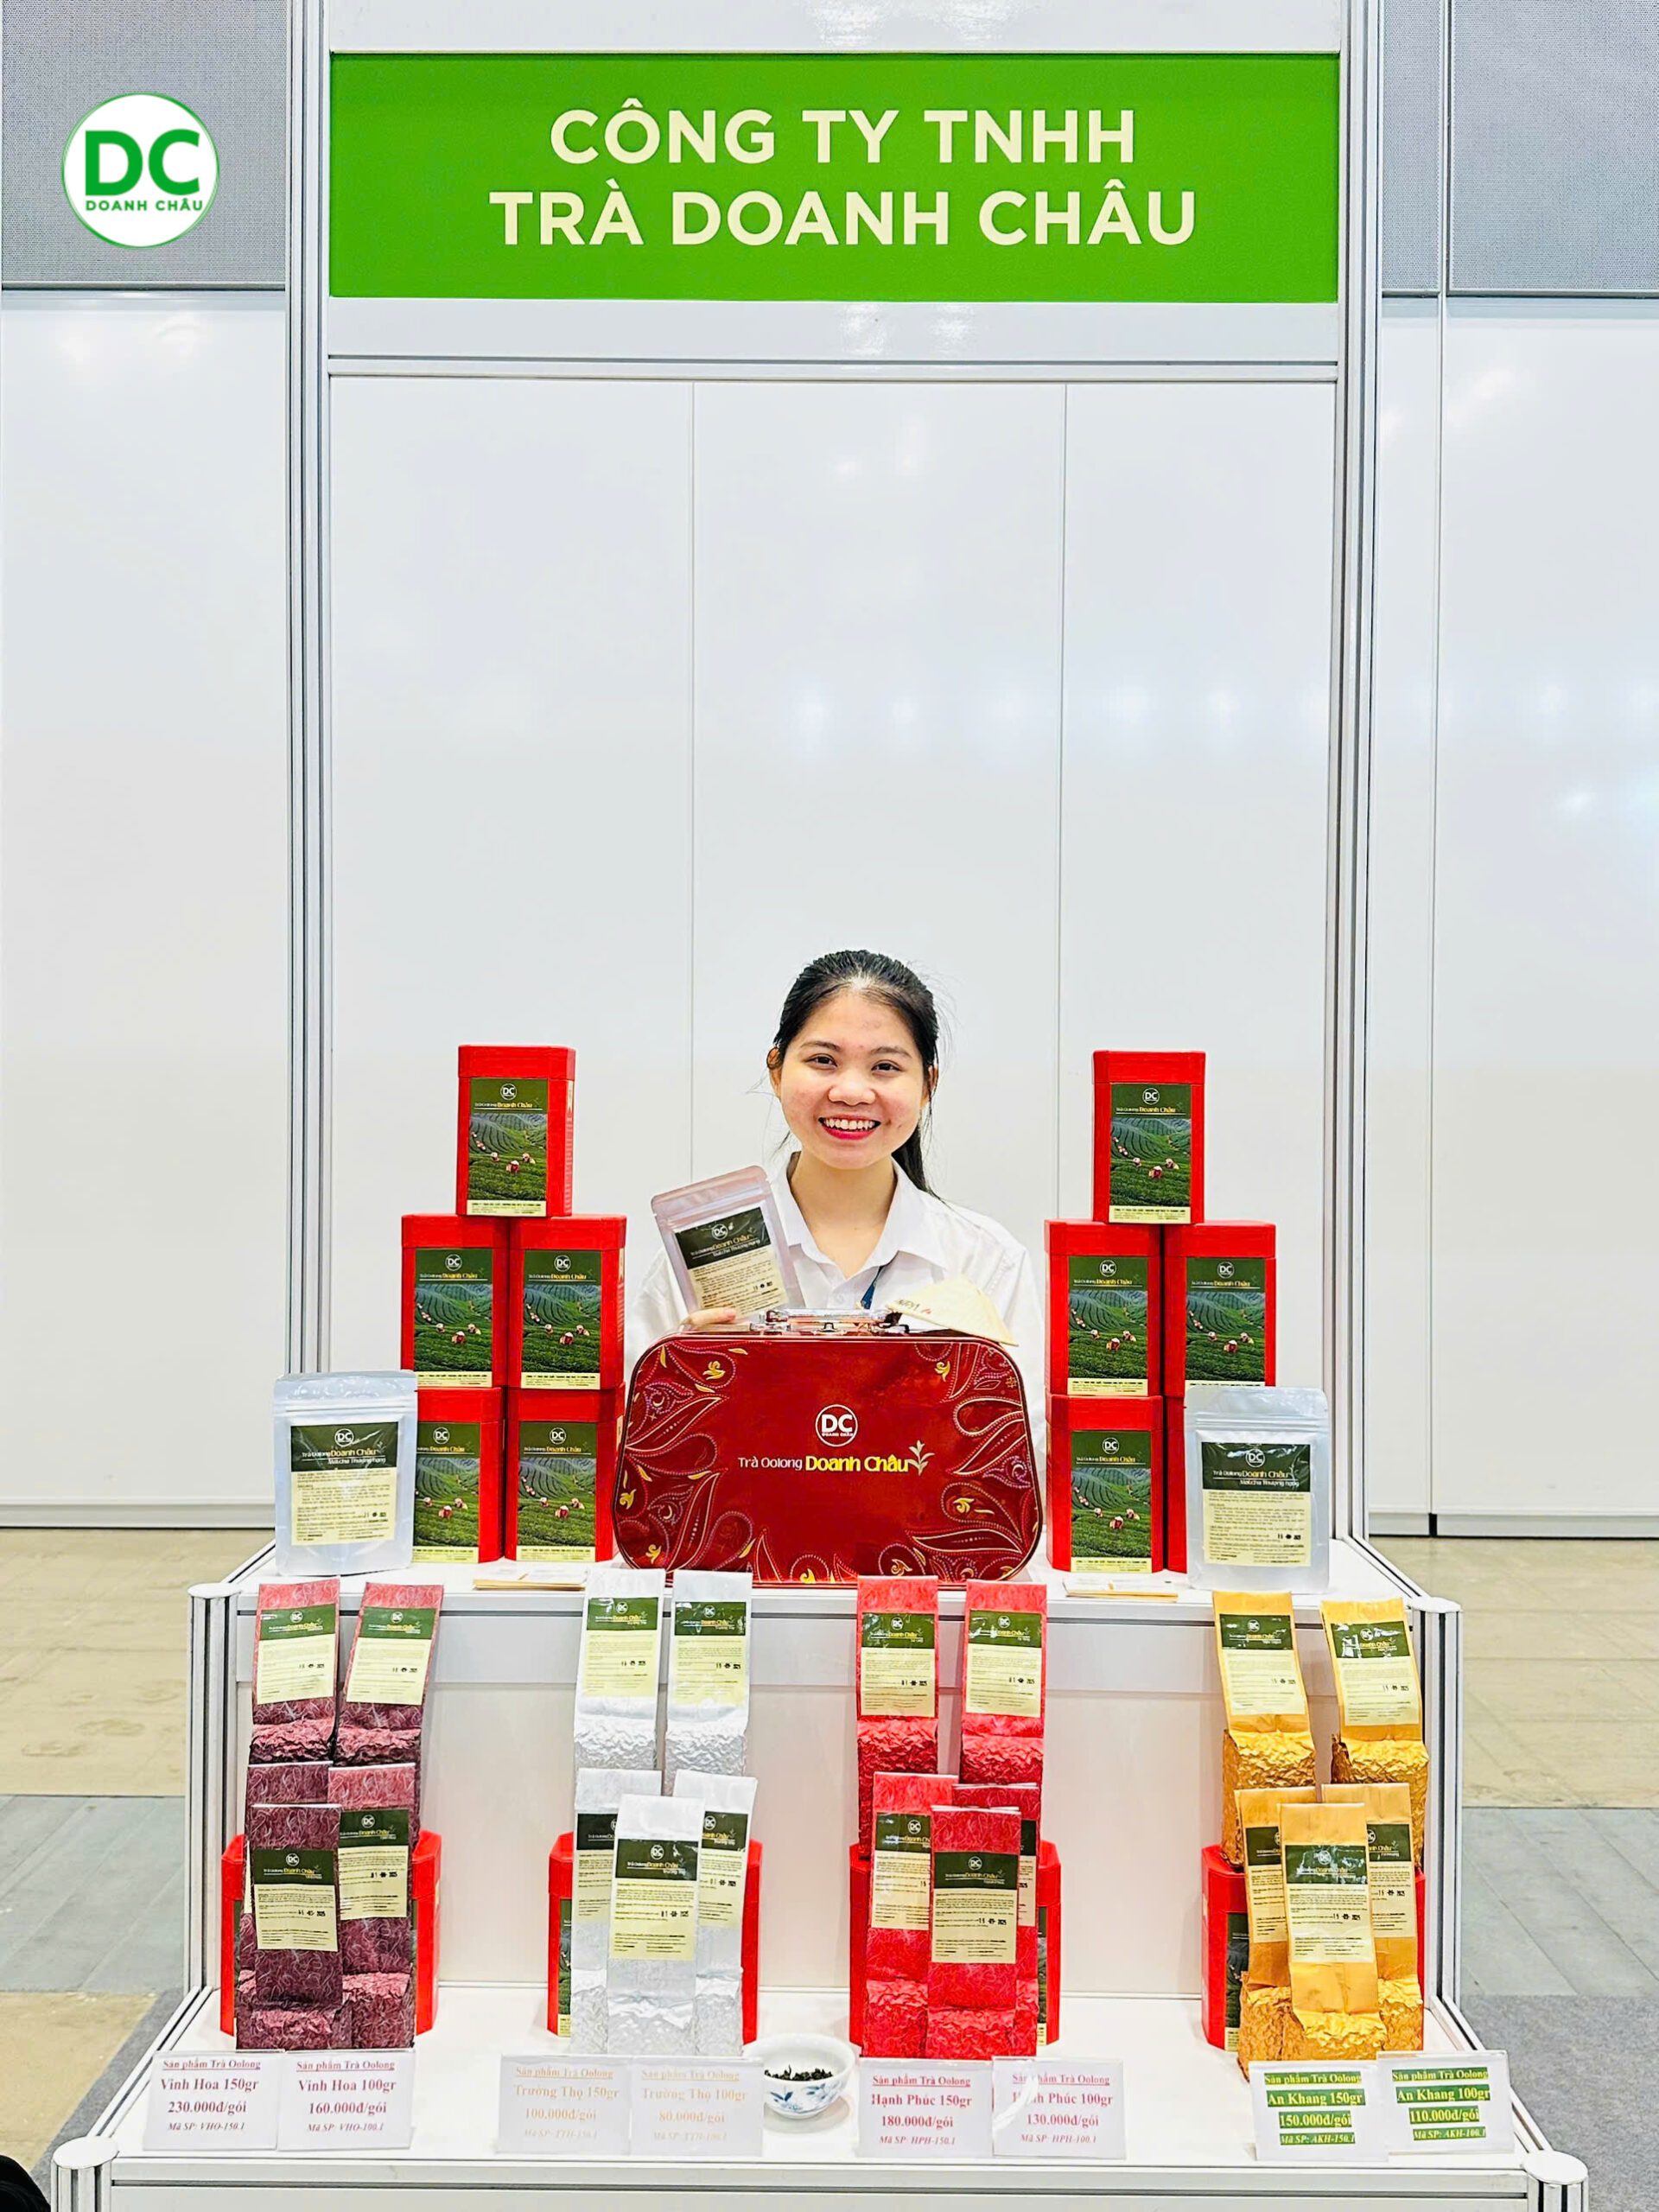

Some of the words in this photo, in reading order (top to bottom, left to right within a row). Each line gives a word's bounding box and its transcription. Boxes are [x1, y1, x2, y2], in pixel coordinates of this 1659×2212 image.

[551, 99, 774, 163] CÔNG
[803, 111, 899, 162] TY
[925, 111, 1133, 162] TNHH
[490, 179, 643, 245] TRÀ
[673, 191, 948, 245] DOANH
[980, 180, 1194, 245] CHÂU
[503, 1087, 514, 1096] DC
[557, 1259, 569, 1268] DC
[1102, 1264, 1115, 1273] DC
[1219, 1266, 1232, 1274] DC
[822, 1414, 853, 1432] DC
[435, 1432, 448, 1440] DC
[551, 1432, 564, 1440] DC
[738, 1456, 759, 1468] Trà
[760, 1457, 803, 1471] Oolong
[805, 1455, 861, 1471] Doanh
[864, 1454, 908, 1472] Châu
[228, 2060, 261, 2070] Oolong
[362, 2061, 395, 2070] Oolong
[919, 2075, 936, 2085] Trà
[938, 2076, 971, 2087] Oolong
[1077, 2075, 1110, 2086] Oolong
[1310, 2074, 1327, 2082] Trà
[1329, 2073, 1362, 2083] Oolong
[1456, 2069, 1488, 2080] Oolong
[194, 2079, 219, 2090] Hoa
[224, 2078, 259, 2093] 150gr
[332, 2080, 357, 2091] Hoa
[362, 2080, 397, 2093] 100gr
[588, 2087, 620, 2101] 150gr
[871, 2094, 903, 2107] Hạnh
[907, 2094, 936, 2106] Phúc
[940, 2094, 972, 2108] 150gr
[1048, 2093, 1077, 2104] Phúc
[1081, 2094, 1113, 2107] 100gr
[1268, 2094, 1285, 2105] An
[1288, 2093, 1327, 2106] Khang
[1330, 2092, 1363, 2106] 150gr
[1397, 2090, 1414, 2101] An
[1416, 2088, 1455, 2101] Khang
[1458, 2087, 1491, 2101] 100gr
[168, 2101, 247, 2115] 230.000đ/gói
[309, 2101, 387, 2115] 160.000đ/gói
[1409, 2108, 1479, 2122] 110.000đ/gói
[881, 2115, 954, 2130] 180.000đ/gói
[1027, 2113, 1099, 2128] 130.000đ/gói
[1280, 2113, 1351, 2127] 150.000đ/gói
